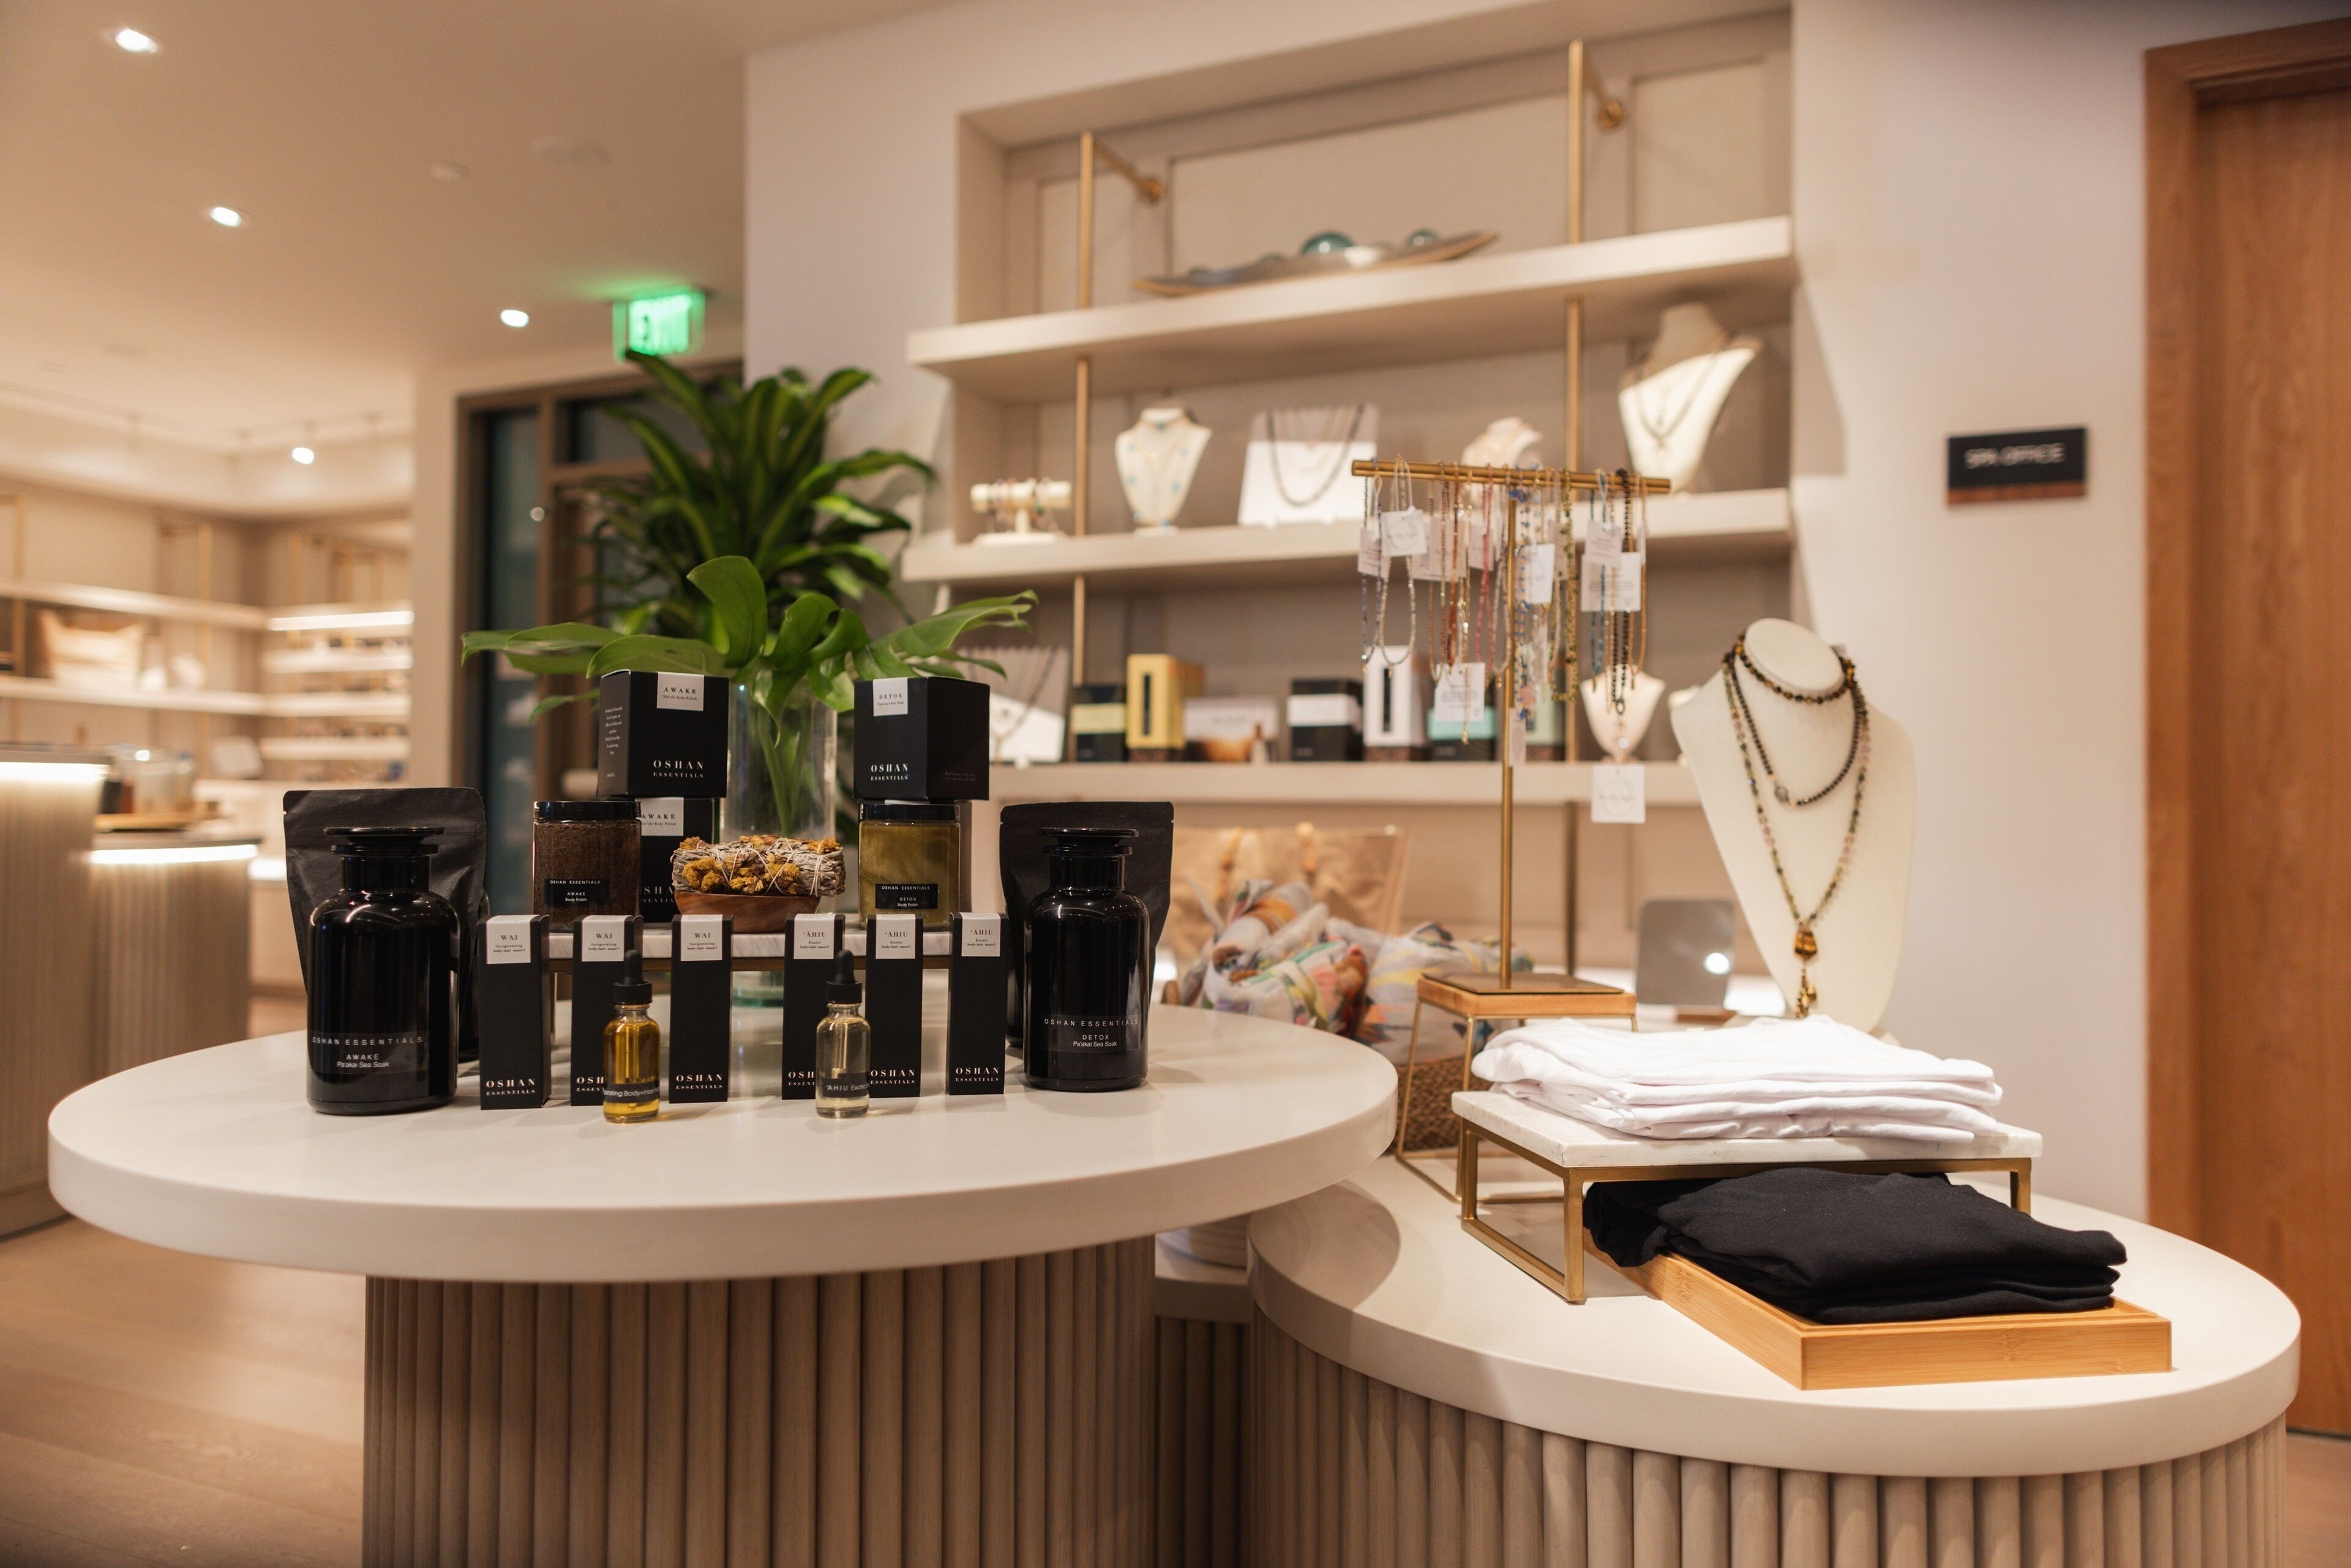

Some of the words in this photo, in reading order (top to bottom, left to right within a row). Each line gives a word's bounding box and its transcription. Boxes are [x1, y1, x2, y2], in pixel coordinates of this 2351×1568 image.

[1964, 448, 1998, 469] SPA
[2000, 443, 2065, 466] OFFICE
[653, 760, 703, 770] OSHAN
[871, 763, 908, 772] OSHAN
[644, 886, 673, 895] SHA
[345, 1037, 422, 1045] ESSENTIALS
[486, 1078, 535, 1088] OSHAN
